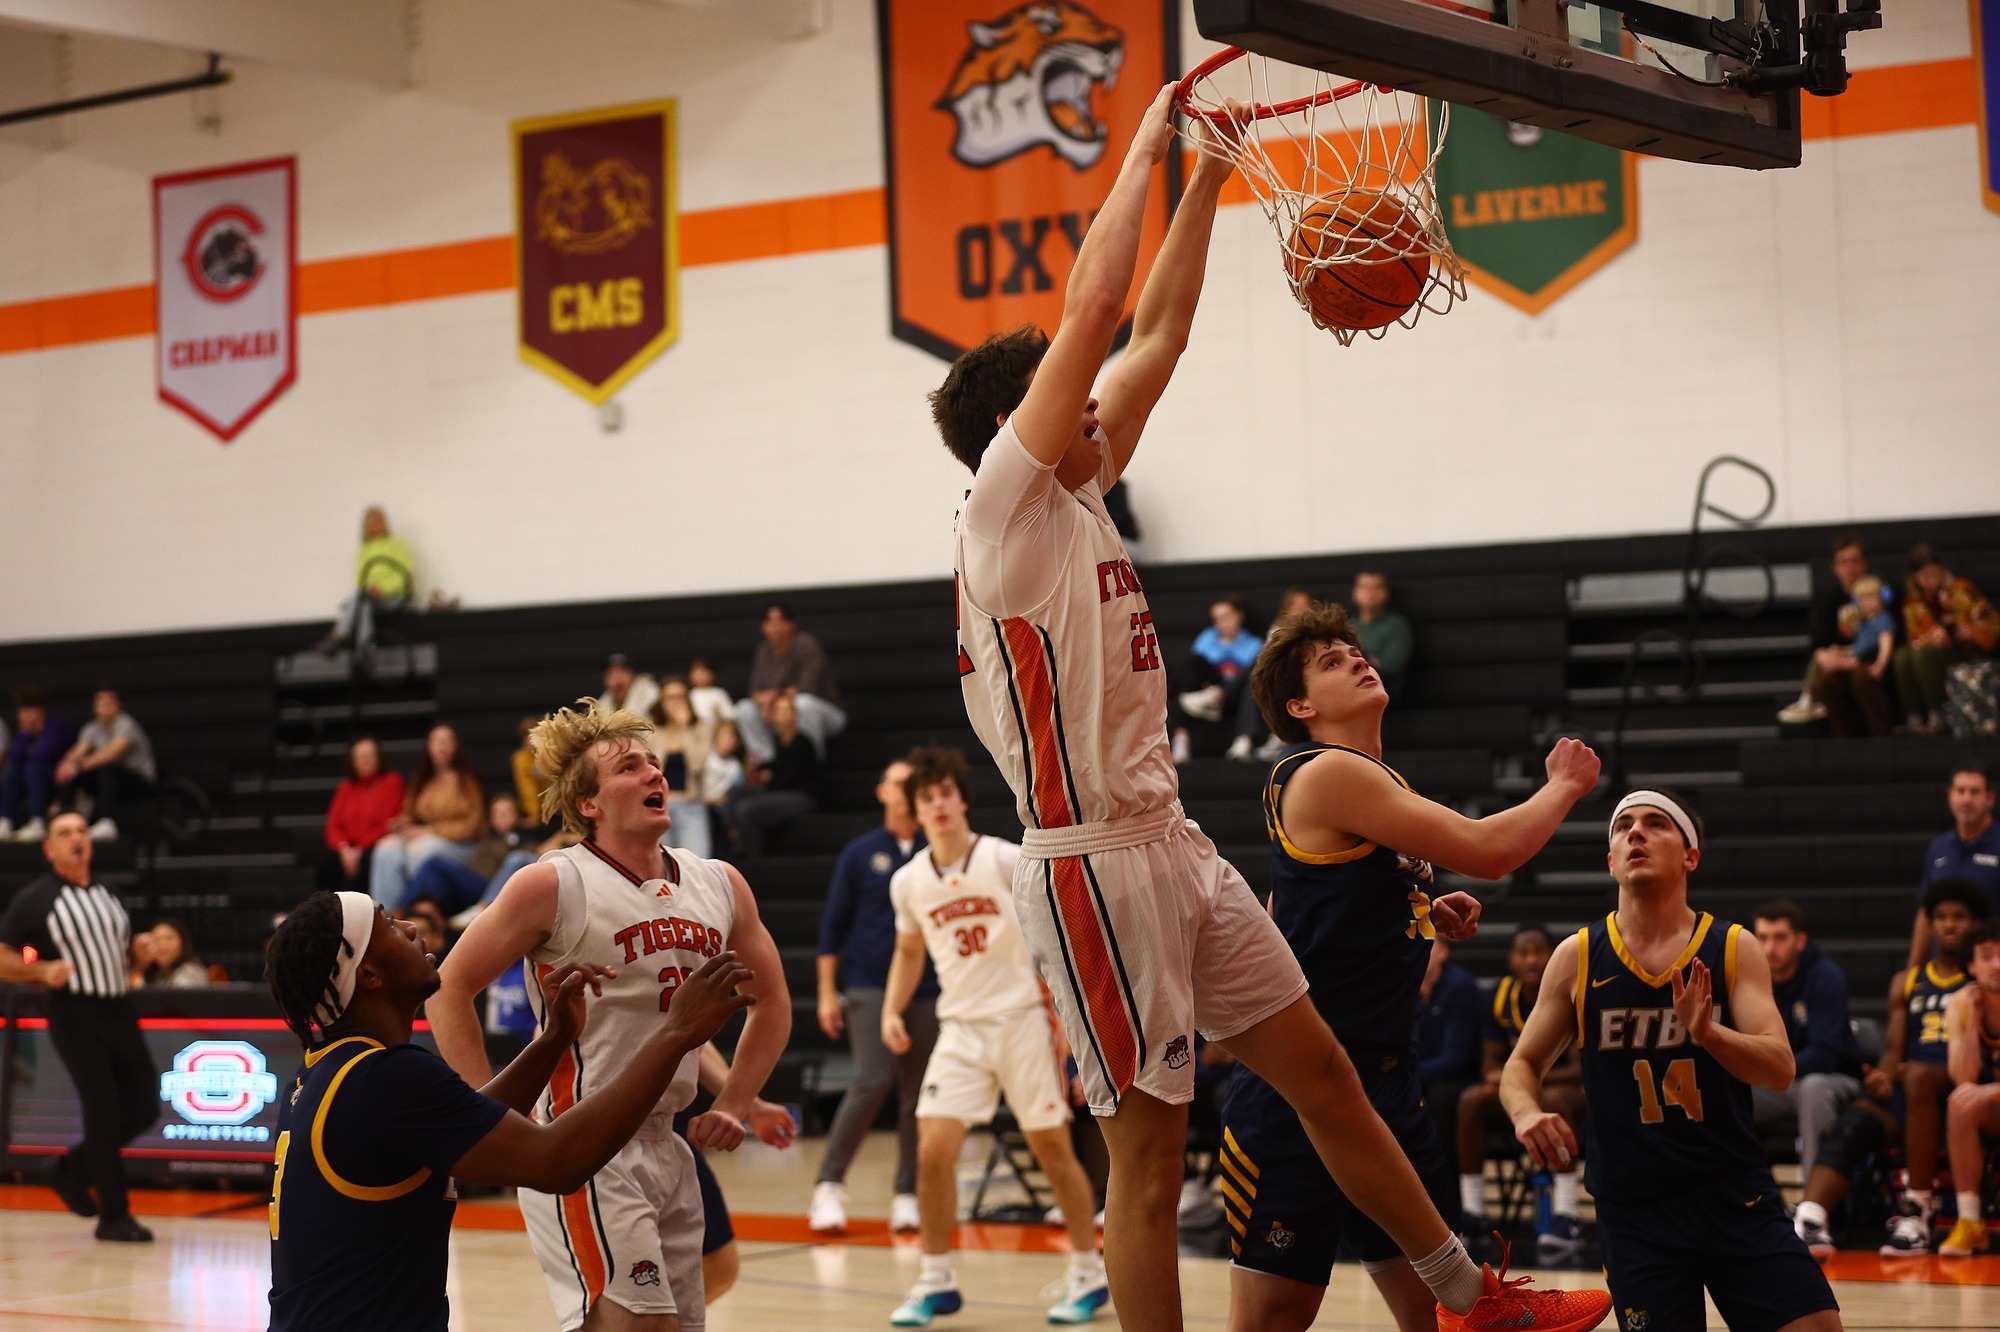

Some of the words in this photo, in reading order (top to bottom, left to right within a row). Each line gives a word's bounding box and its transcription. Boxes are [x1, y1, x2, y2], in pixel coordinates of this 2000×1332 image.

[1452, 180, 1606, 227] LAVERNE
[549, 277, 643, 334] CMS
[169, 329, 276, 369] CHAPMAN
[614, 917, 723, 964] TIGERS
[955, 925, 987, 956] 30
[1633, 1058, 1704, 1124] 14
